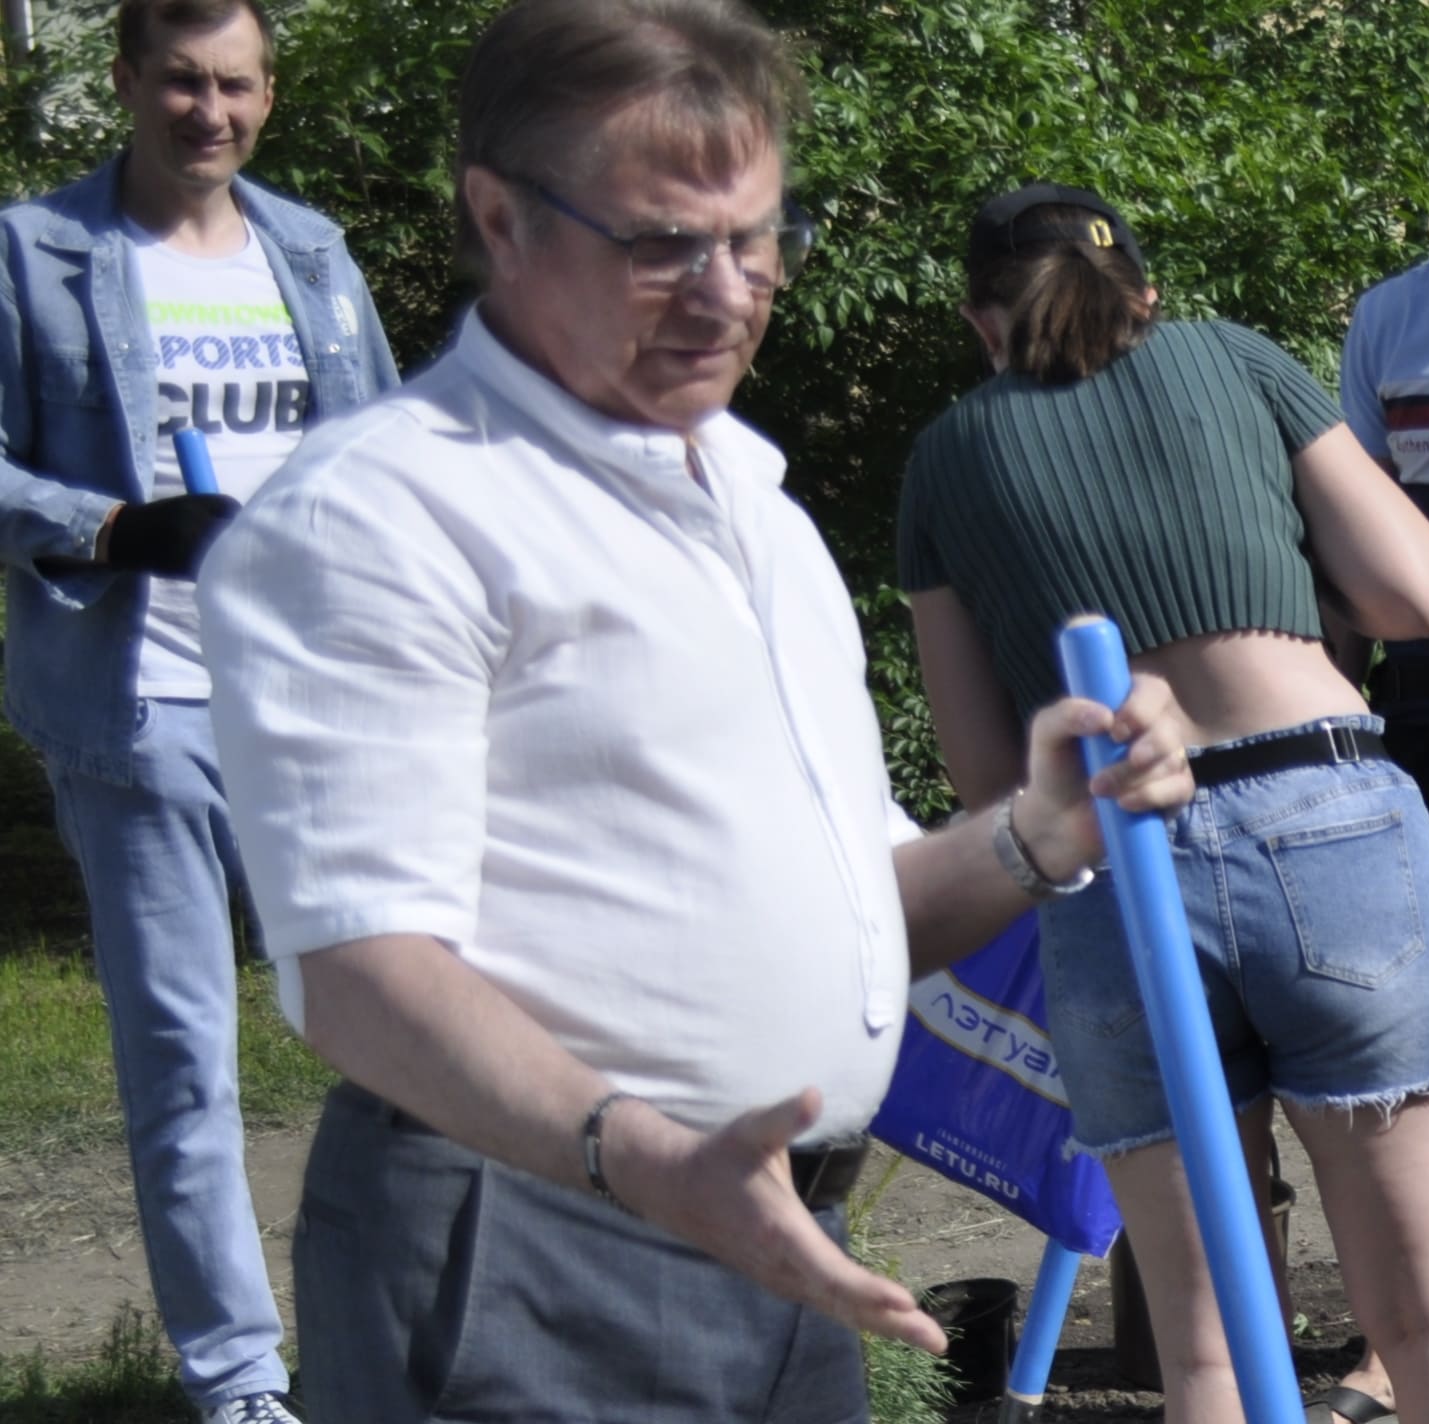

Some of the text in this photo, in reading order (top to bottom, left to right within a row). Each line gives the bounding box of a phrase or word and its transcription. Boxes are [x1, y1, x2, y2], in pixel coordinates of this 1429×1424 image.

[147, 302, 294, 326] OWNTOW
[155, 333, 306, 371] PORTS
[157, 380, 311, 437] CLUB
[915, 1131, 1020, 1200] LETU.RU
